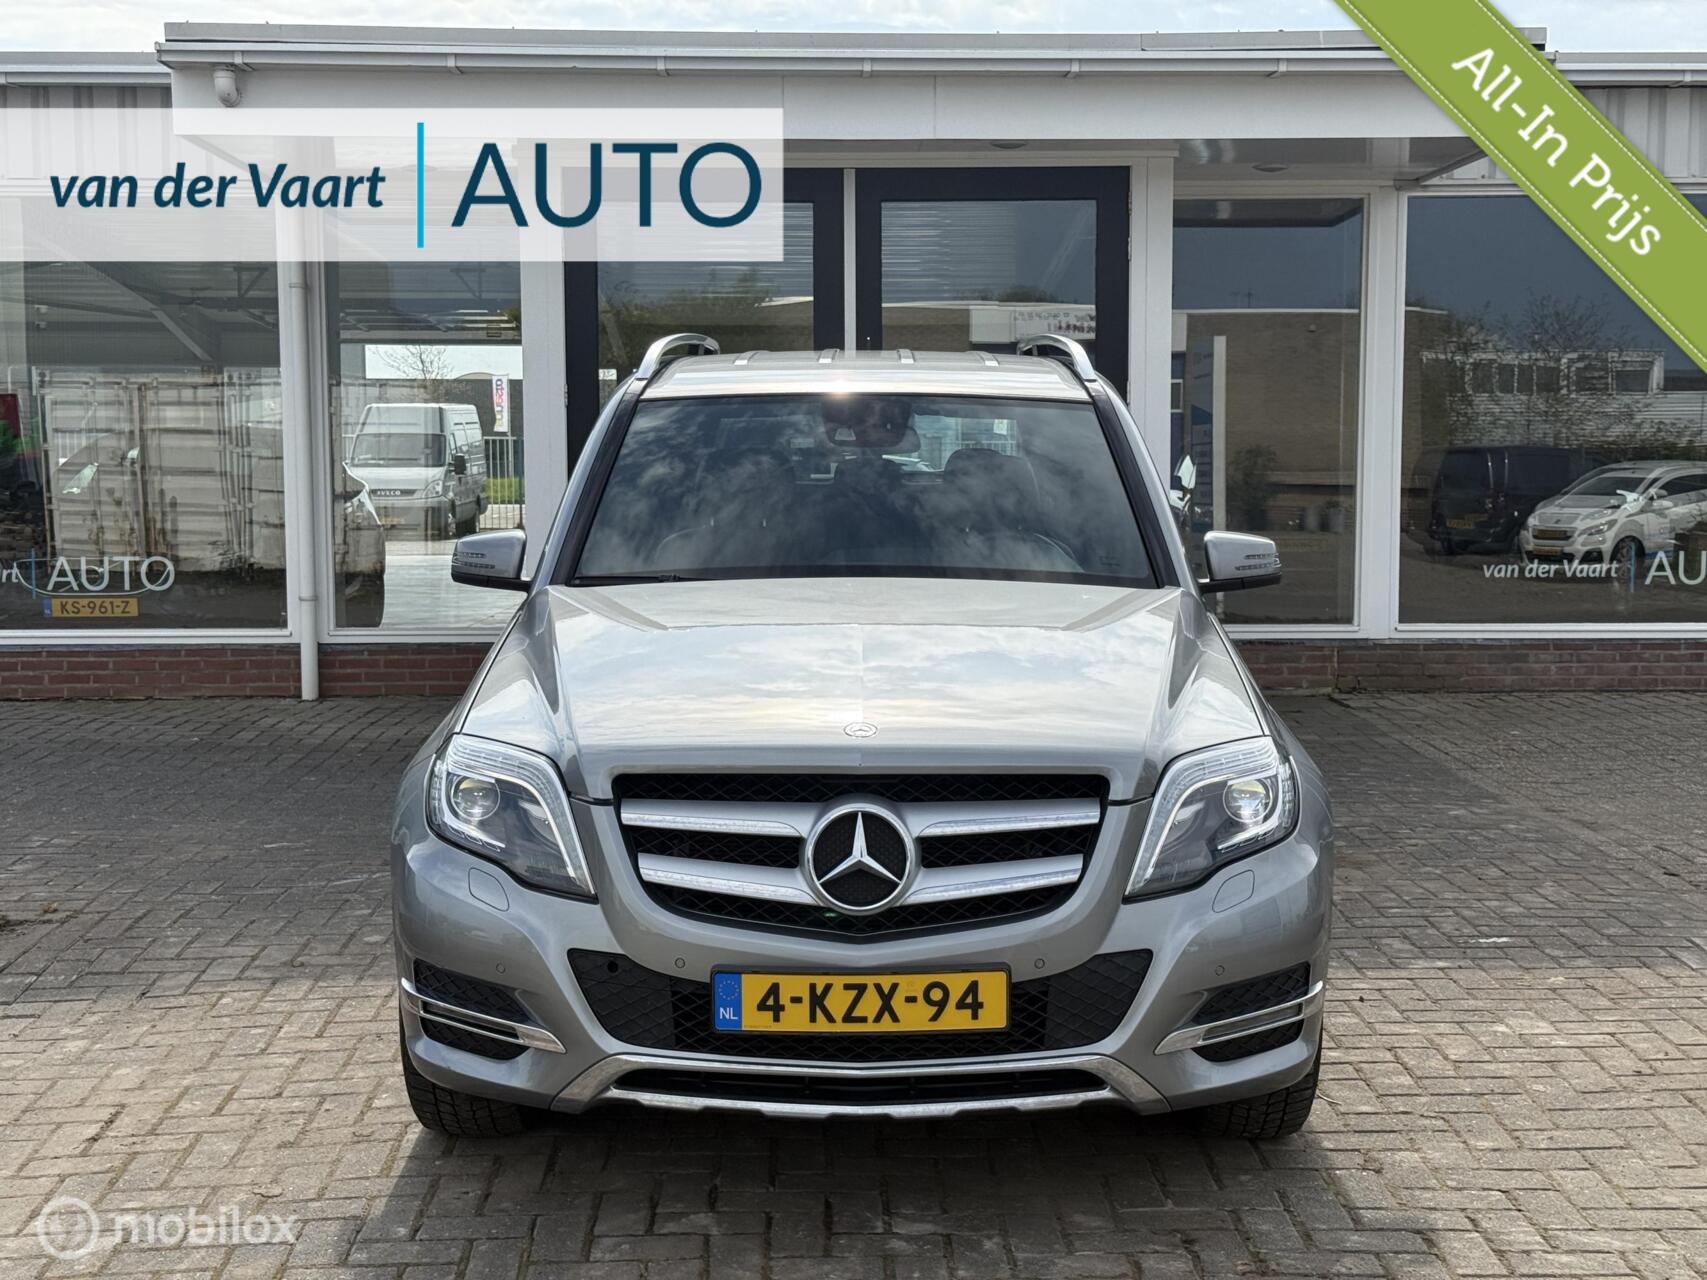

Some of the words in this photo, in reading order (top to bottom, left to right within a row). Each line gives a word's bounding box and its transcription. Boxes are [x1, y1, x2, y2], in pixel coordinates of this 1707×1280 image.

[47, 556, 175, 591] AUTO
[1483, 564, 1519, 578] van
[1524, 559, 1560, 578] der
[1563, 559, 1620, 578] Vaart
[1644, 550, 1707, 585] AU
[59, 600, 131, 615] KS-961-Z
[719, 1007, 738, 1020] NL
[756, 979, 984, 1024] 4-KZX-94
